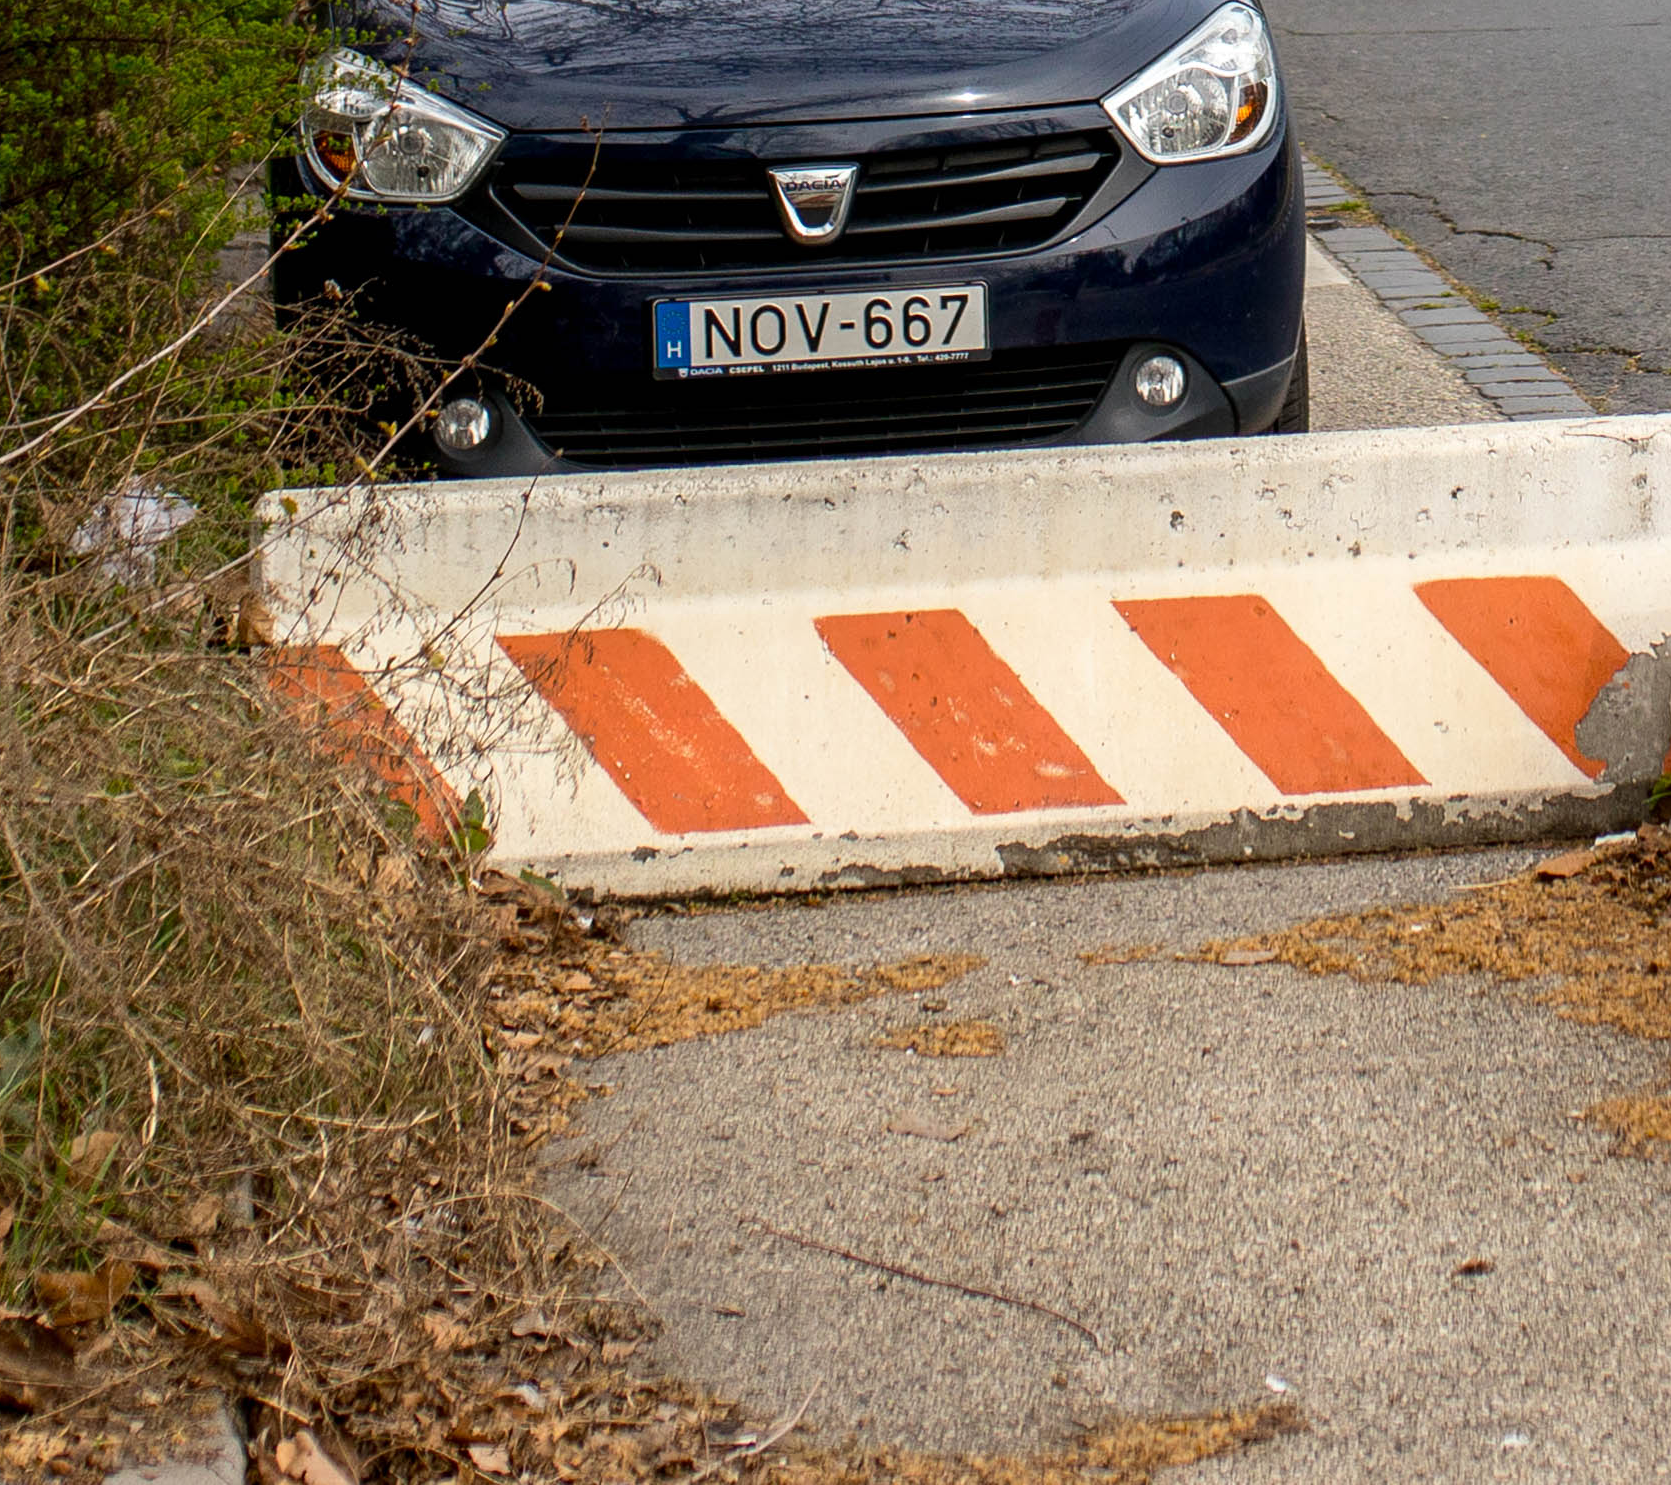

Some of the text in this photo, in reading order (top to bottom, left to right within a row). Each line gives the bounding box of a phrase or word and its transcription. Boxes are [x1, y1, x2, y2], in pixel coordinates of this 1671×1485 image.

[785, 179, 843, 191] DACIA
[704, 293, 969, 359] NOV-667
[666, 341, 682, 359] H
[690, 366, 723, 376] DACIA
[729, 365, 765, 374] CSEPEL
[772, 363, 790, 372] 1211
